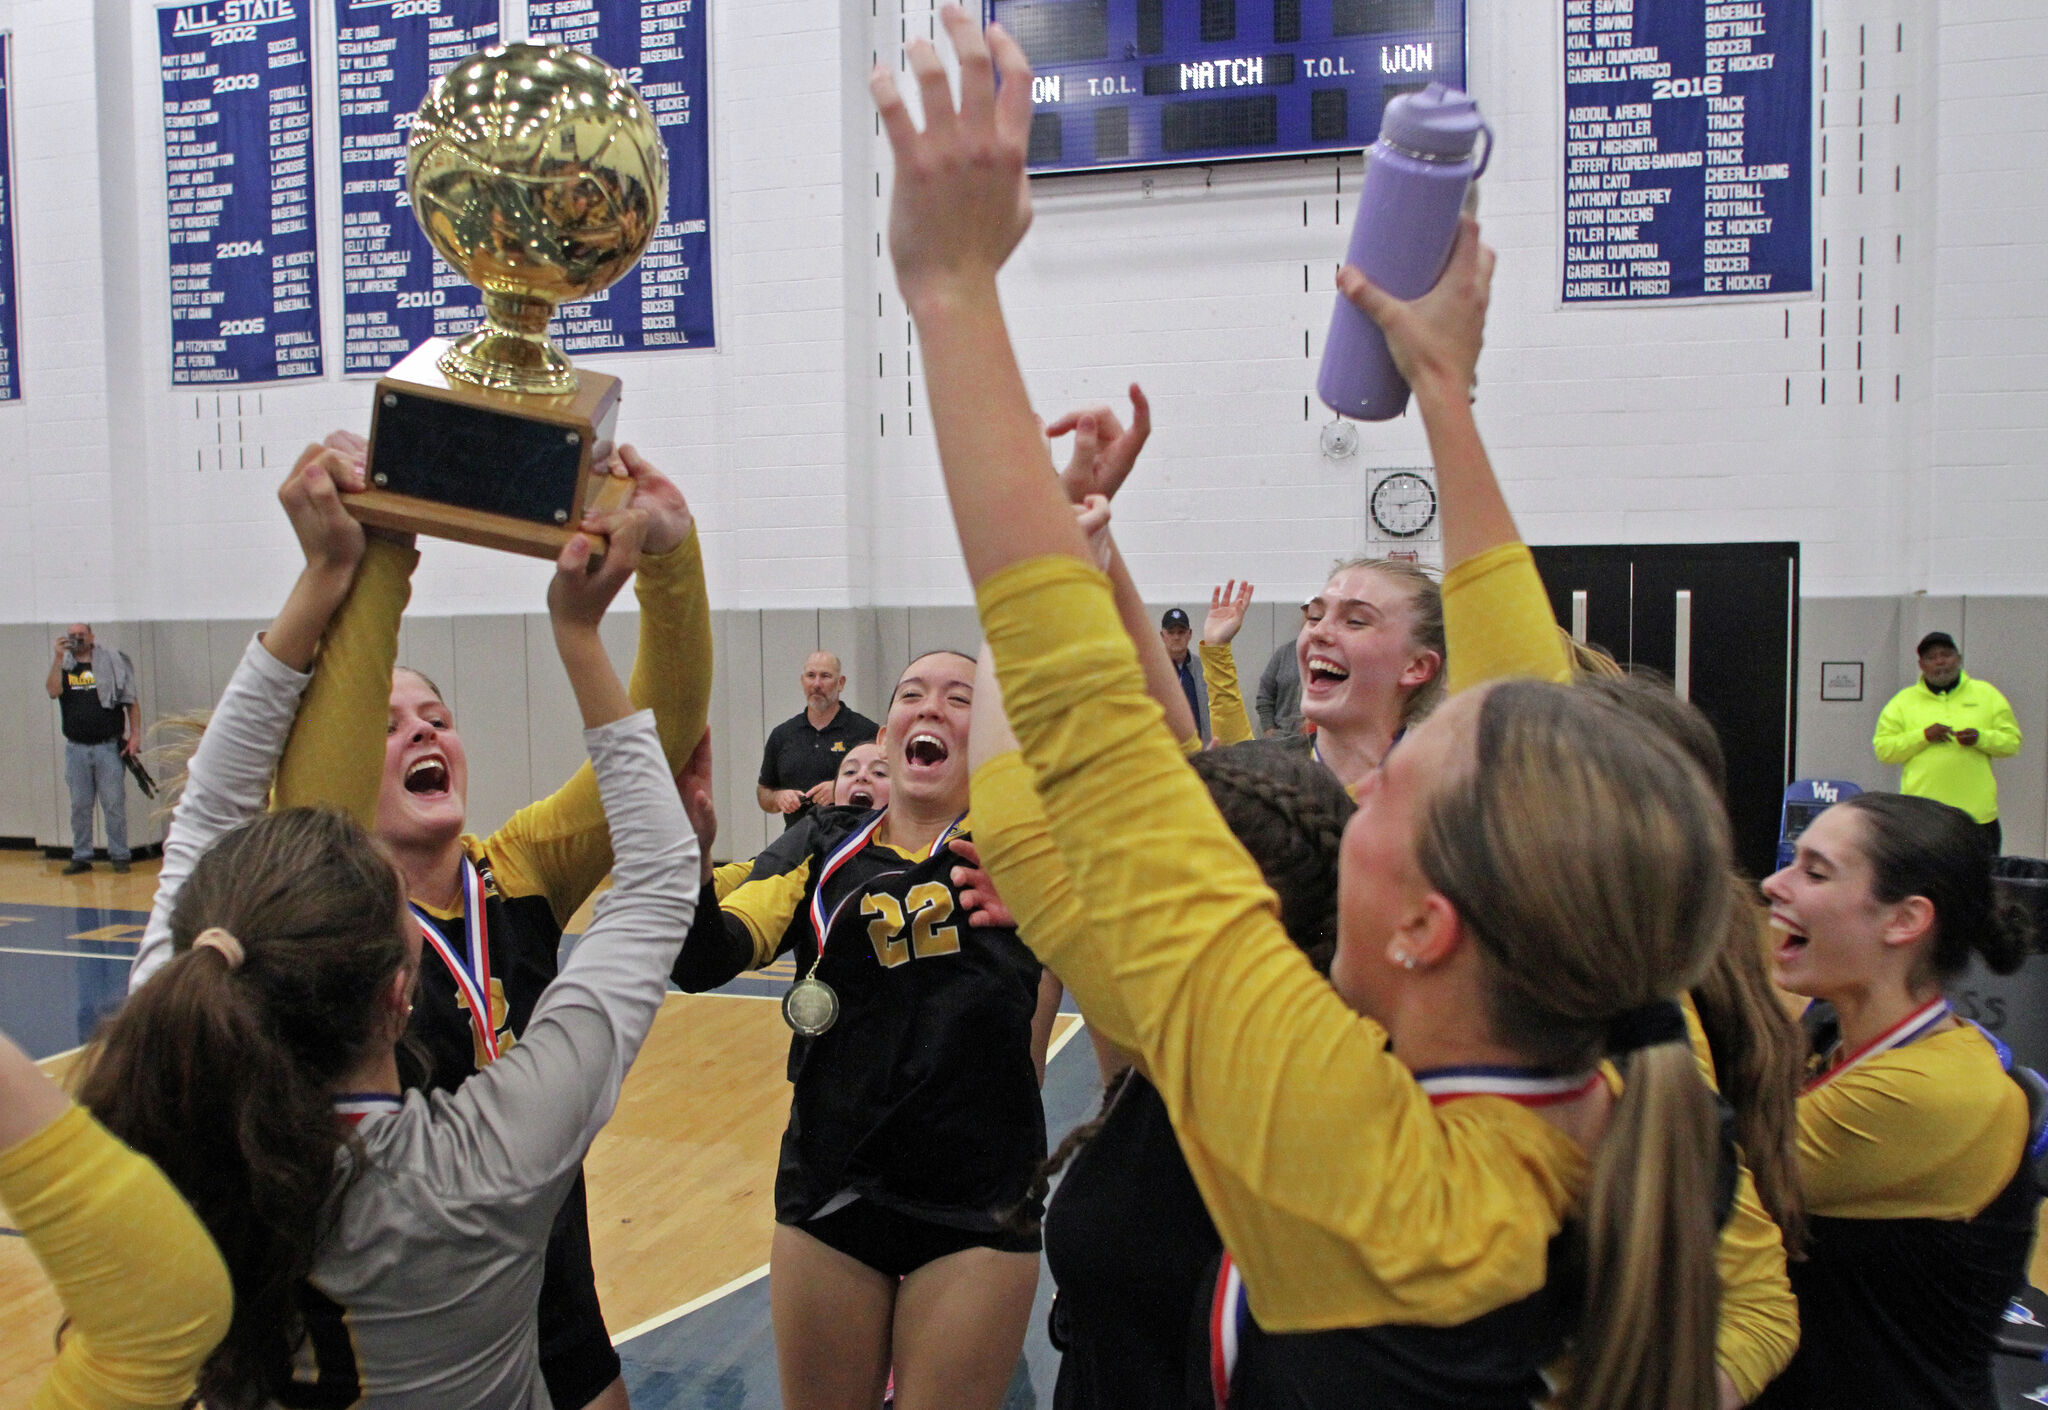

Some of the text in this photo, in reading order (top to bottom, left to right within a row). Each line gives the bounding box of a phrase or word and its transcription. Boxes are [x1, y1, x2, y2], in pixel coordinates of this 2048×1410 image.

[391, 0, 441, 19] 2006
[657, 0, 691, 16] HOCKEY
[1567, 0, 1634, 15] MIKE SAVINO
[1705, 2, 1766, 22] BASEBALL
[640, 16, 686, 33] SOFTBALL
[1567, 14, 1633, 32] MIKE SAVINO
[1706, 19, 1766, 39] SOFTBALL
[211, 26, 258, 46] 2002
[1596, 31, 1632, 48] WATTS
[640, 47, 684, 64] BASEBALL
[1706, 38, 1752, 56] SOCCER
[1303, 58, 1356, 77] T.O.L.
[1382, 43, 1433, 74] WON
[1567, 50, 1604, 67] SALAH
[1706, 53, 1775, 73] ICE HOCKEY
[1180, 56, 1263, 90] MATCH
[1568, 62, 1671, 83] GABRIELLA PRISCO
[212, 73, 259, 94] 2003
[640, 82, 685, 97] FOOTBALL
[1031, 76, 1061, 104] ON
[1087, 76, 1137, 96] T.O.L.
[1652, 75, 1723, 99] 2016
[1707, 95, 1745, 112] TRACK
[1569, 120, 1651, 139] TALON BUTLER
[1707, 113, 1745, 130] TRACK
[1568, 137, 1658, 156] DREW HIGHSMITH
[1707, 131, 1744, 147] TRACK
[1568, 151, 1703, 173] JEFFERY FLORES-SANTIAGO
[1706, 148, 1744, 165] TRACK
[1568, 173, 1631, 190] AMANI CAYO
[1705, 163, 1790, 182] CHEERLEADING
[1568, 188, 1672, 208] ANTHONY GODFREY
[1705, 183, 1765, 200] FOOTBALL
[1568, 206, 1654, 225] BYRON DICKENS
[1705, 200, 1765, 217] FOOTBALL
[1568, 225, 1639, 243] TYLER PAINE
[1705, 218, 1772, 236] ICE HOCKEY
[216, 240, 264, 259] 2004
[1568, 246, 1604, 261] SALAH
[1704, 238, 1750, 254] SOCCER
[641, 253, 683, 269] FOOTBALL
[1567, 261, 1670, 279] GABRIELLA PRISCO
[1704, 256, 1750, 273] SOCCER
[641, 267, 690, 284] ICE HOCKEY
[1704, 274, 1772, 291] ICE HOCKEY
[641, 283, 684, 299] SOFTBALL
[1566, 279, 1670, 297] GABRIELLA PRISCO
[396, 290, 445, 309] 2010
[641, 299, 674, 314] SOCCER
[219, 317, 265, 336] 2005
[642, 315, 676, 330] SOCCER
[643, 332, 689, 346] BASEBALL
[1812, 781, 1840, 804] WH
[859, 881, 961, 969] 22
